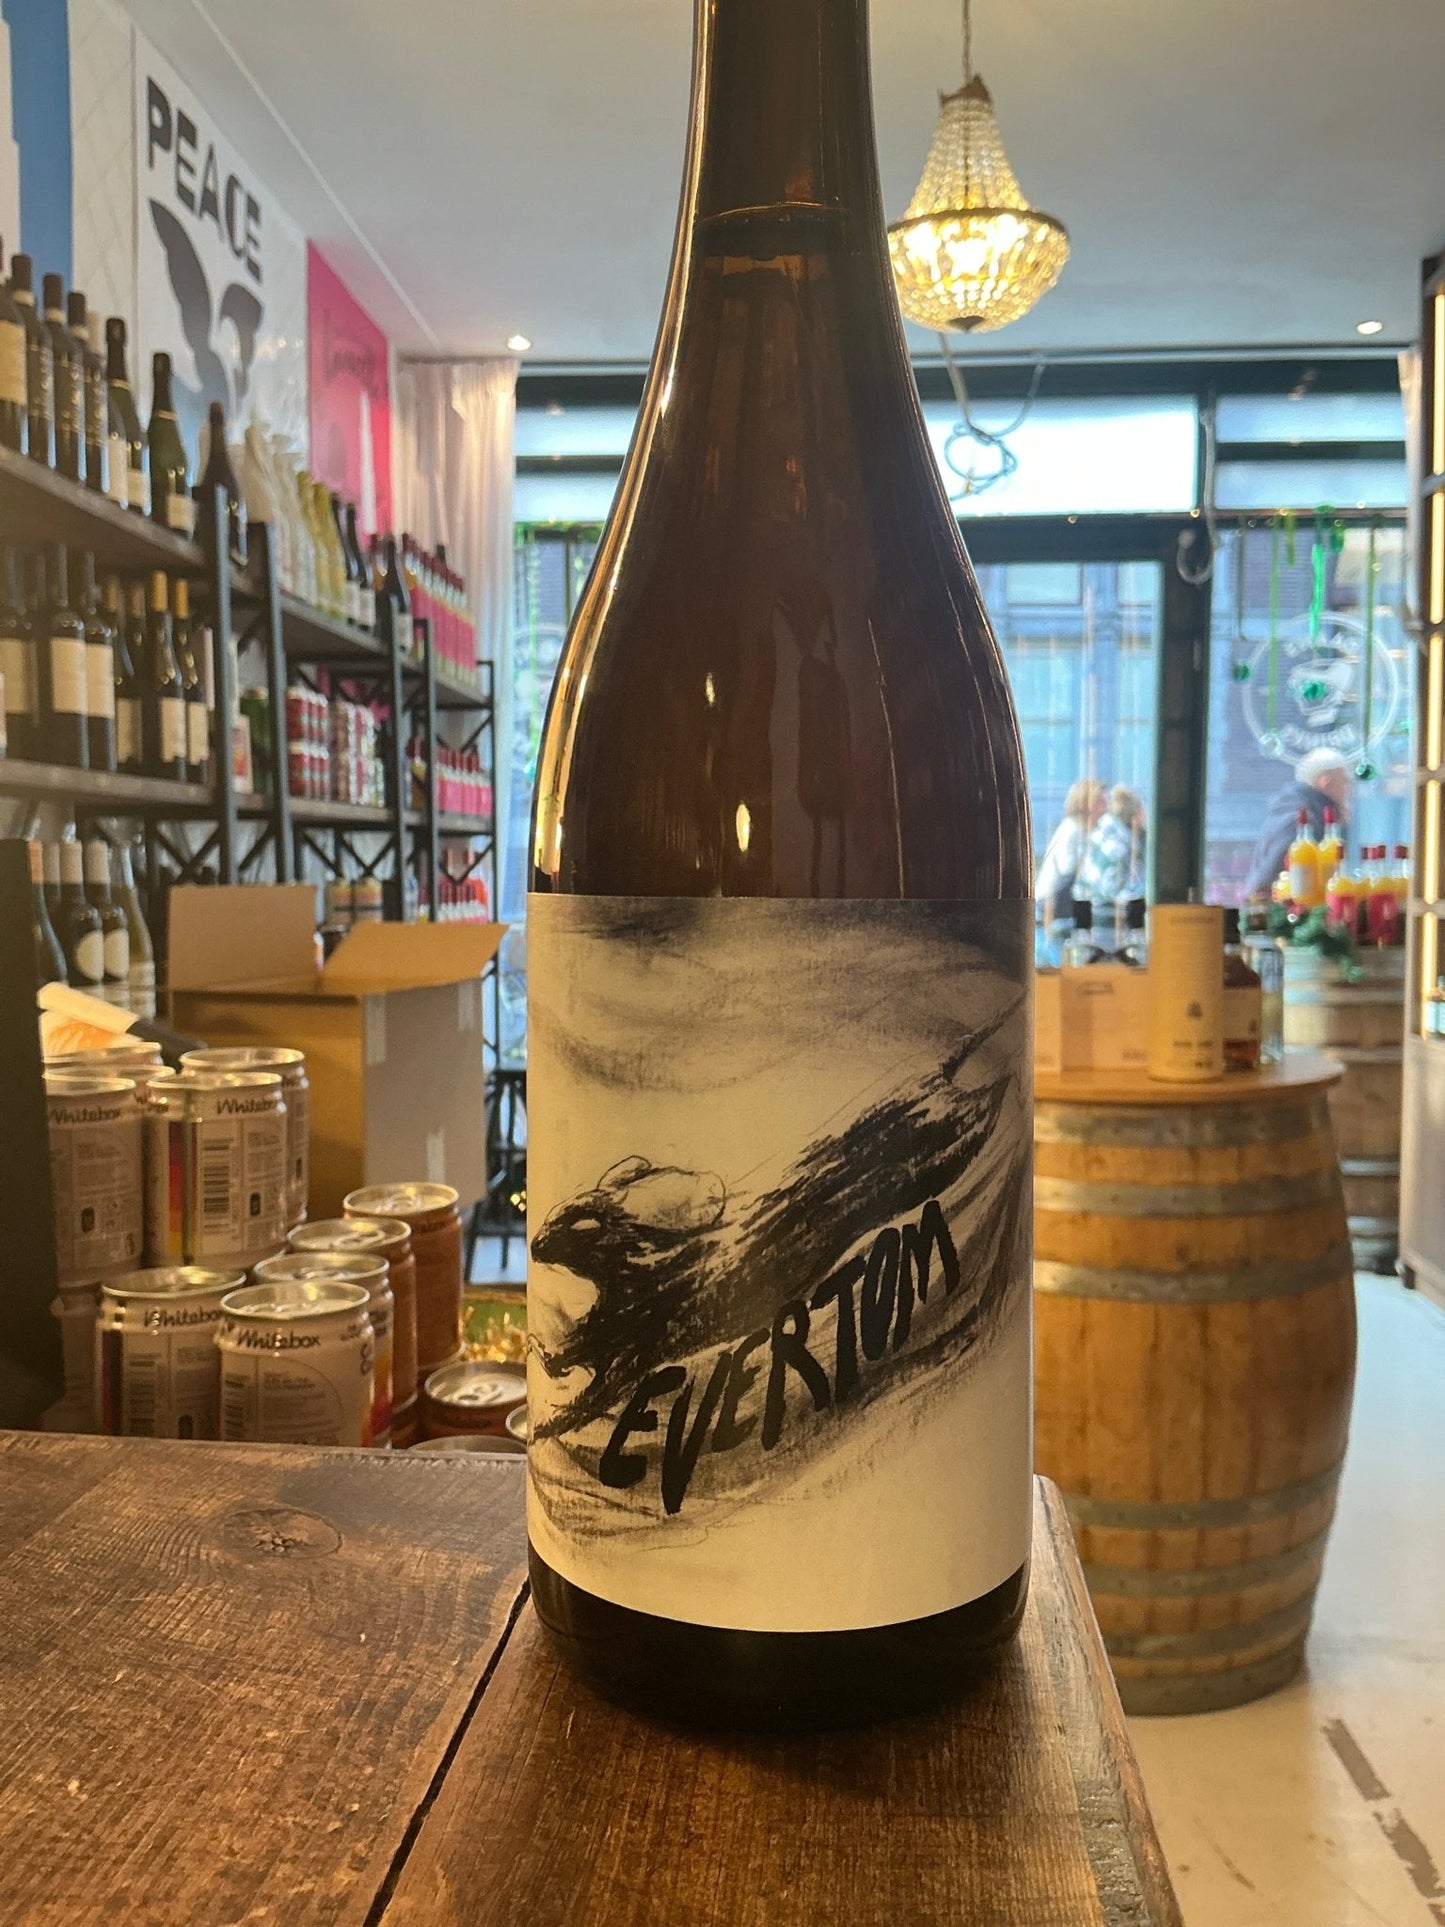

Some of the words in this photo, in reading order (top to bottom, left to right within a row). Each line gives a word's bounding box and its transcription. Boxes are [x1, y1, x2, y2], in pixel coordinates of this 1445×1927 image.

[147, 76, 262, 284] PEACE
[217, 1098, 276, 1115] Whiteb
[237, 1331, 321, 1350] Whitebox
[599, 1200, 961, 1514] EVERTOM
